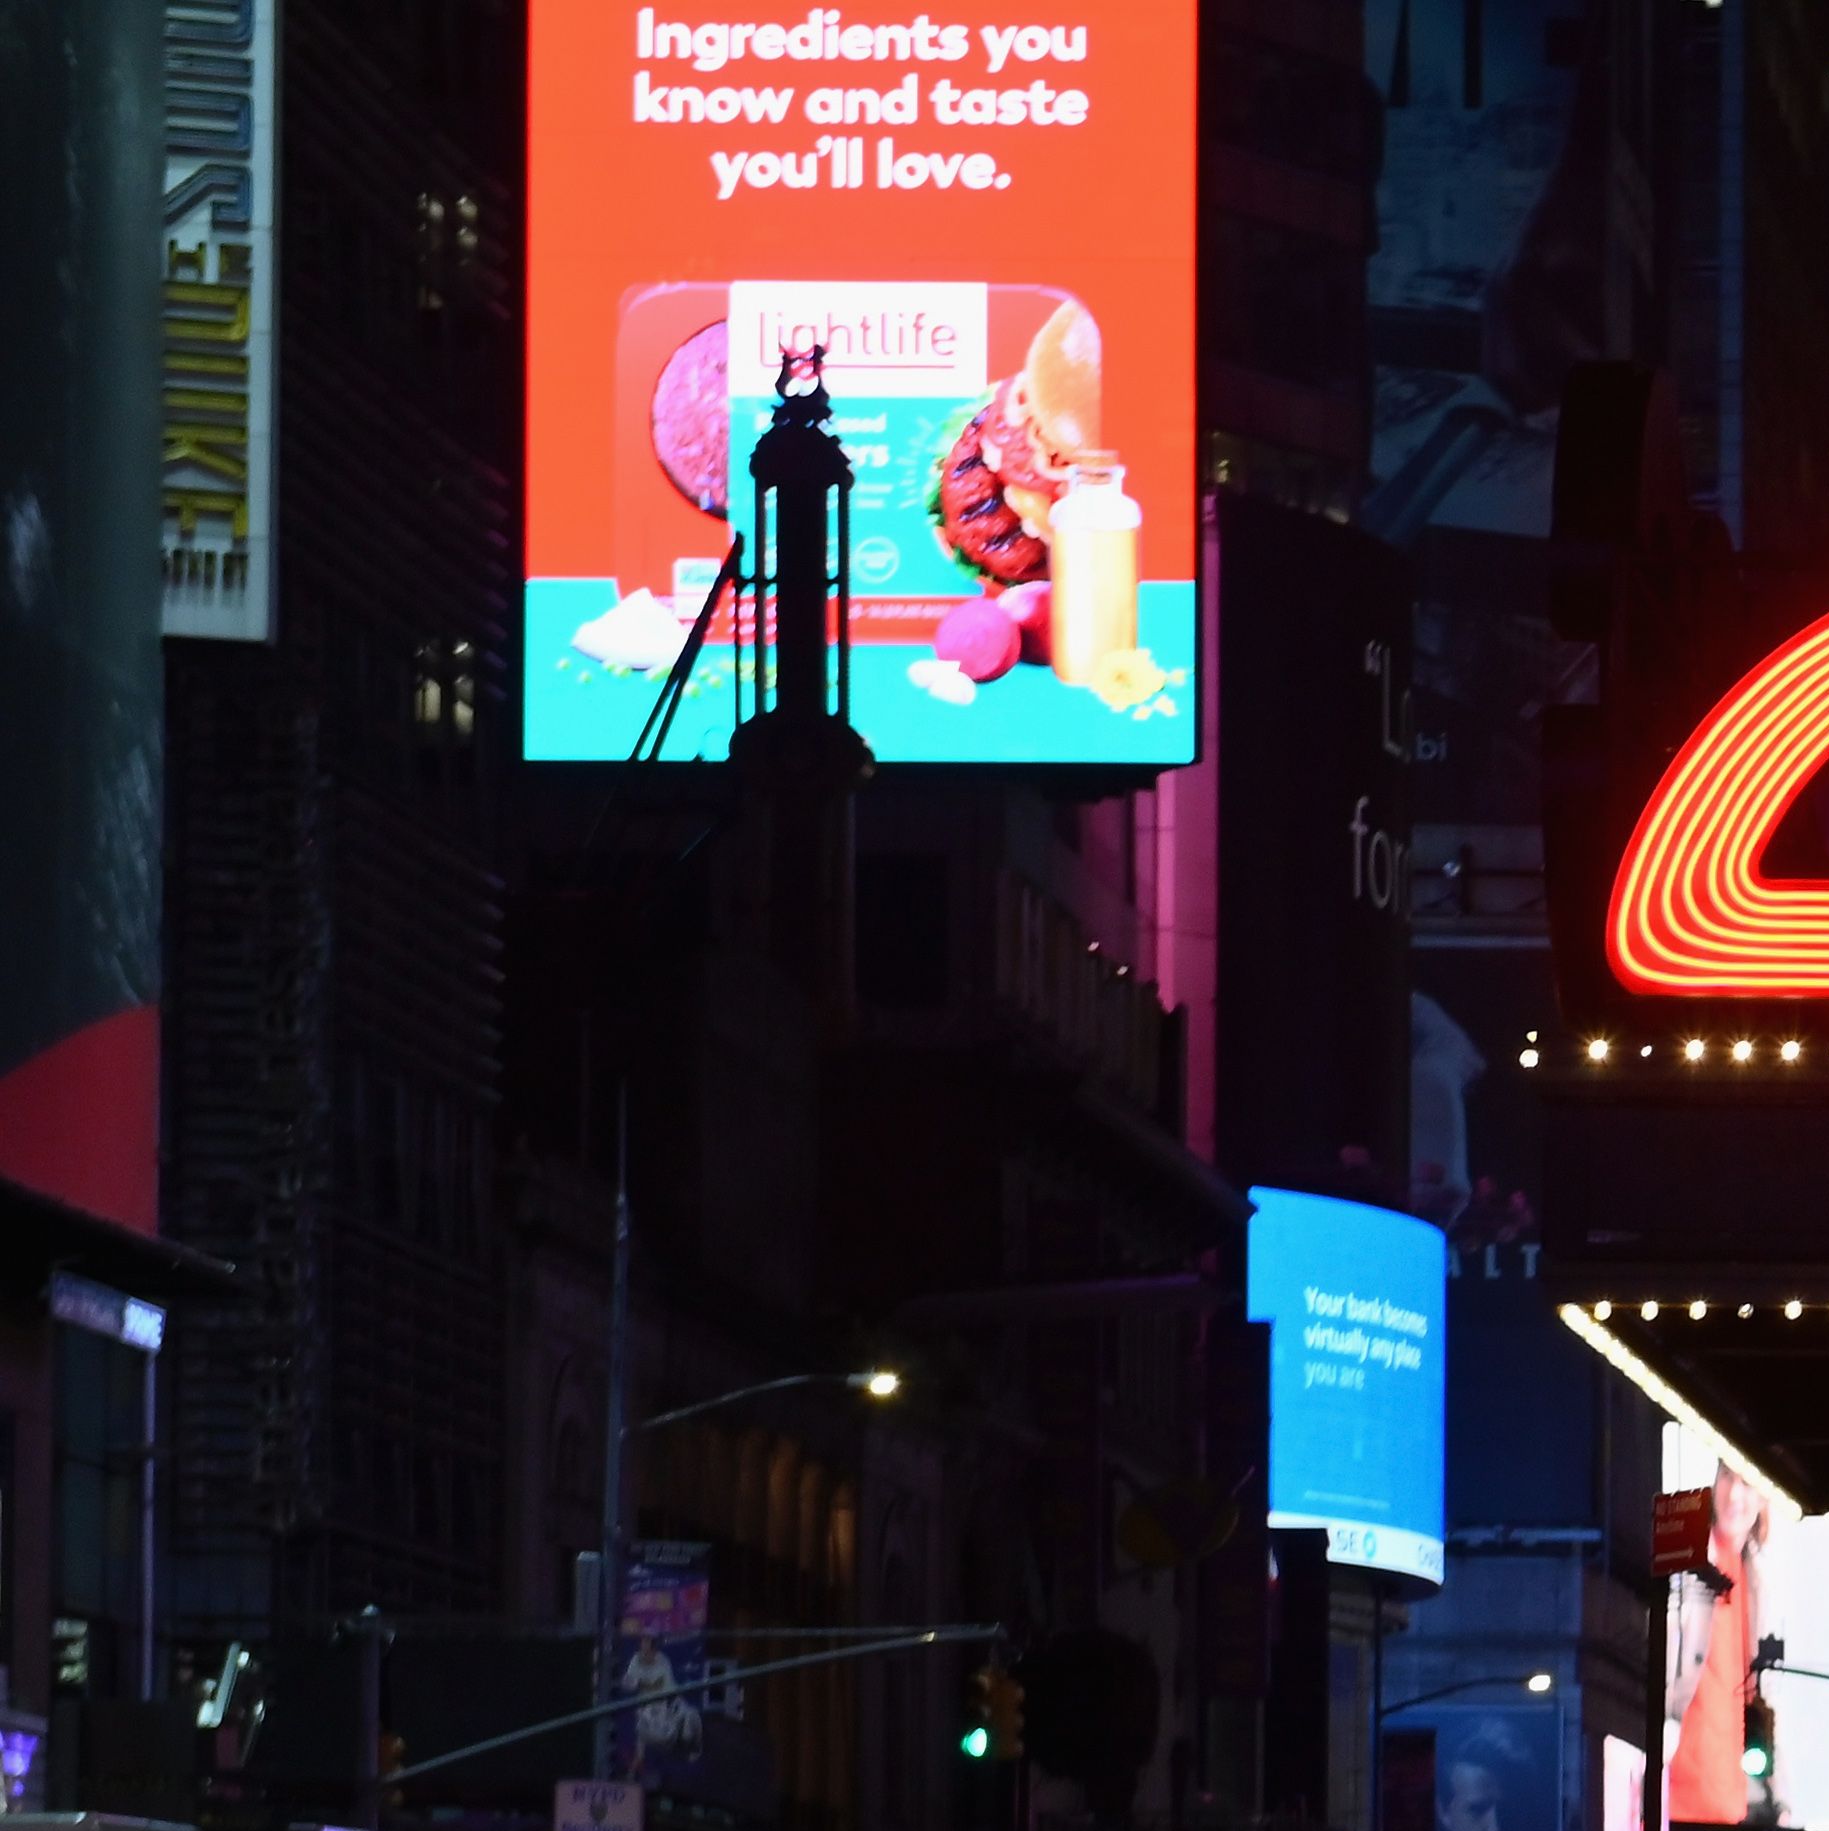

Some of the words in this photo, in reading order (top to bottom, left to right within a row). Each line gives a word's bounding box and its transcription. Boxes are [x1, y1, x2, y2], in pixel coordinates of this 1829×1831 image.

[636, 8, 968, 71] Ingredients
[981, 22, 1087, 72] you
[633, 71, 793, 122] know
[804, 73, 917, 125] and
[930, 79, 1089, 126] taste
[710, 135, 863, 200] you'll
[877, 138, 1011, 190] love.
[759, 311, 957, 367] lightlife
[1304, 1286, 1345, 1318] Your
[1304, 1361, 1337, 1389] you
